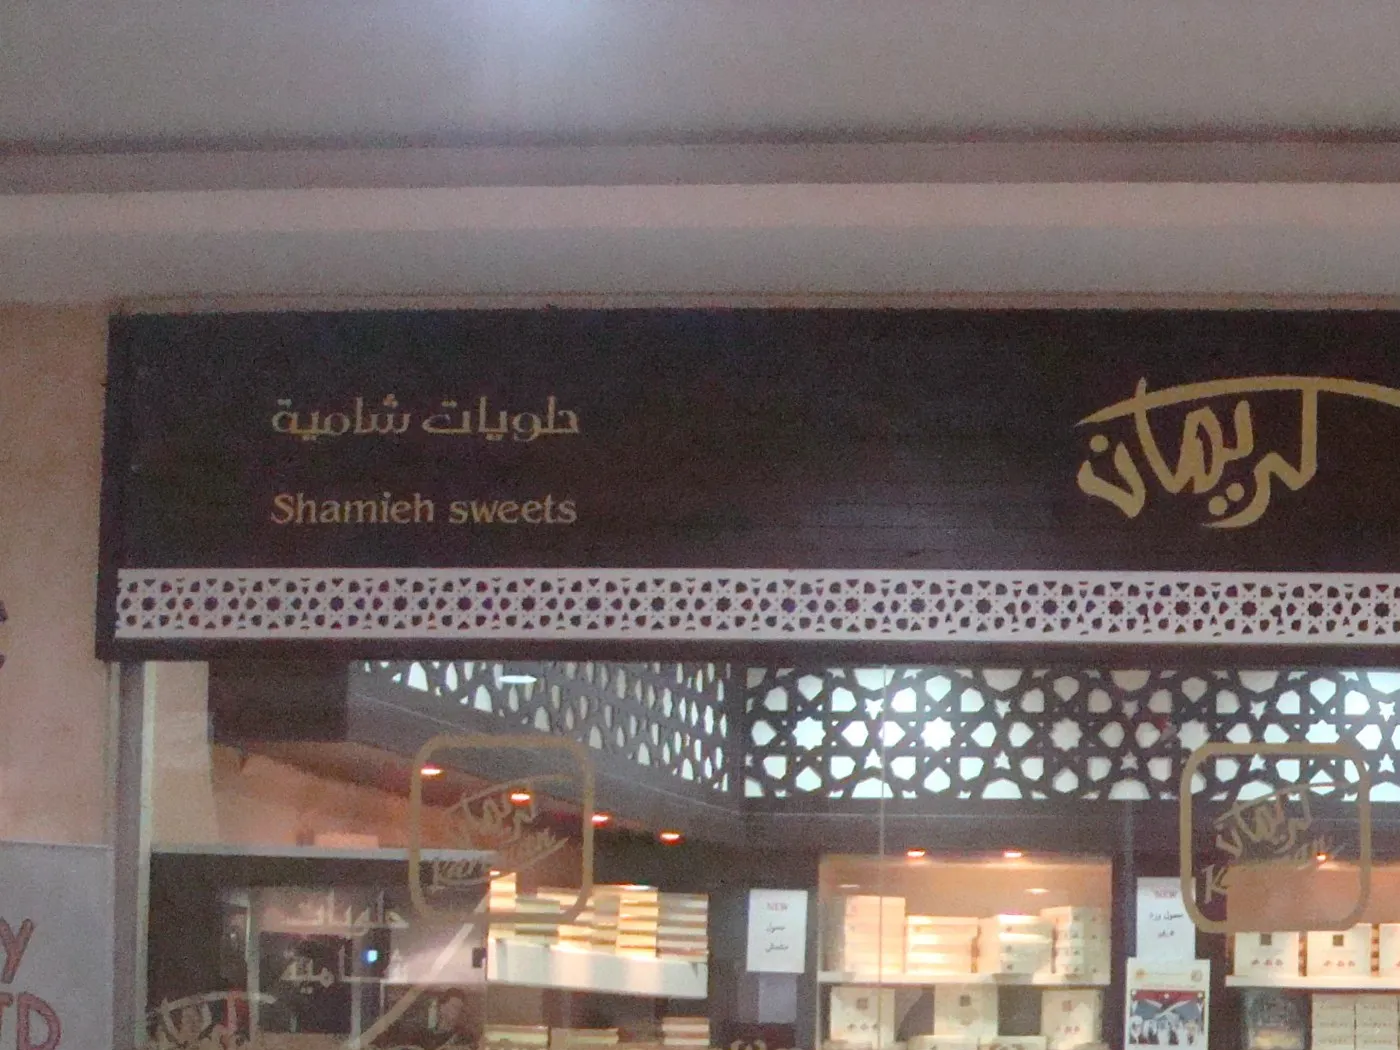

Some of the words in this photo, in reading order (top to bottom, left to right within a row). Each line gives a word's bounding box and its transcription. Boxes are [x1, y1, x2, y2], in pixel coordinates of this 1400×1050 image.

[271, 393, 411, 442] شامية
[421, 394, 581, 442] حلويات
[270, 491, 435, 525] Shamieh
[448, 493, 578, 525] sweets
